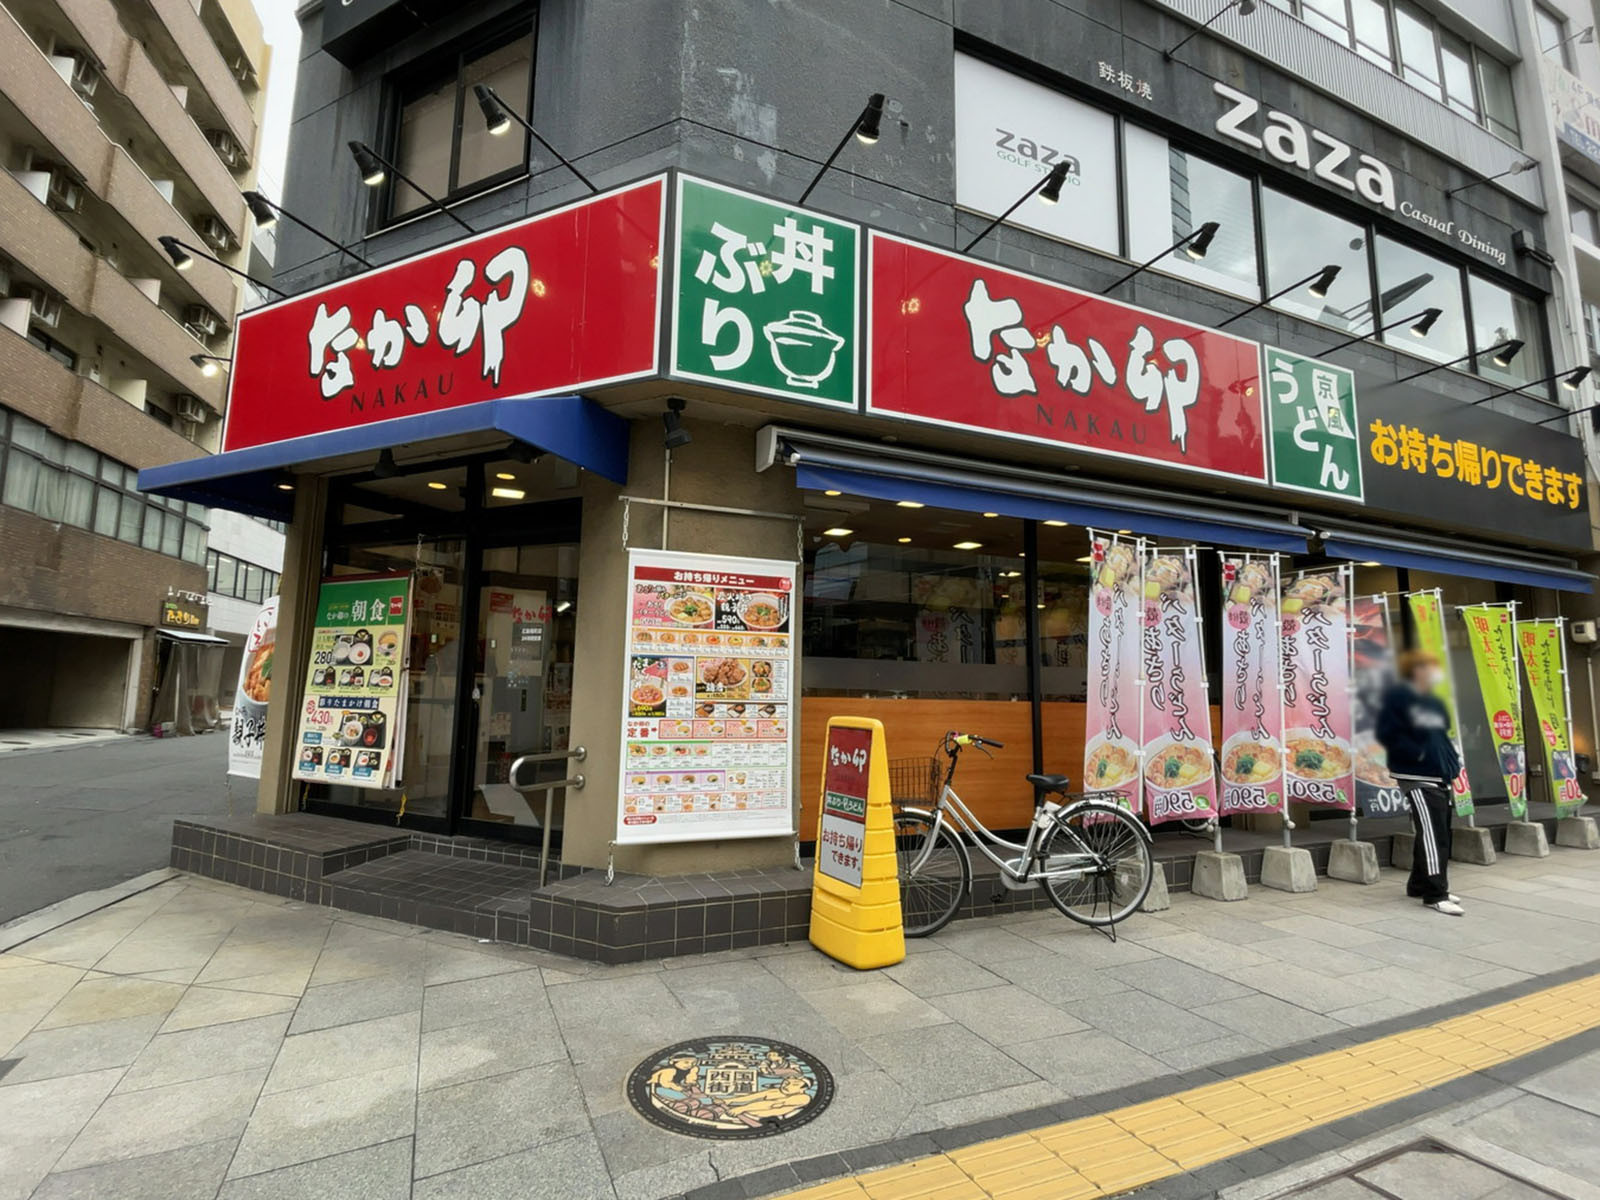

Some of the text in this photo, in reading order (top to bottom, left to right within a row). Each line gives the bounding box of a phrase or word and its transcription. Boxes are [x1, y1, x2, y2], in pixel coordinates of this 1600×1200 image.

[995, 128, 1081, 177] zaza
[1213, 81, 1396, 211] zaza
[997, 150, 1082, 187] GOLF STIO
[1399, 201, 1507, 266] Casual Dining
[308, 246, 529, 399] なか卯
[963, 278, 1200, 455] なか卯
[349, 373, 454, 415] NAKAU
[1036, 403, 1147, 444] NAKAU
[1271, 358, 1349, 490] うどん
[1370, 418, 1582, 510] お持ち帰りできます
[673, 571, 755, 585] お持ち帰りメニュー
[351, 598, 386, 623] 朝食
[314, 651, 333, 665] 280
[830, 744, 867, 773] なか卯
[822, 829, 863, 854] お持ち帰り
